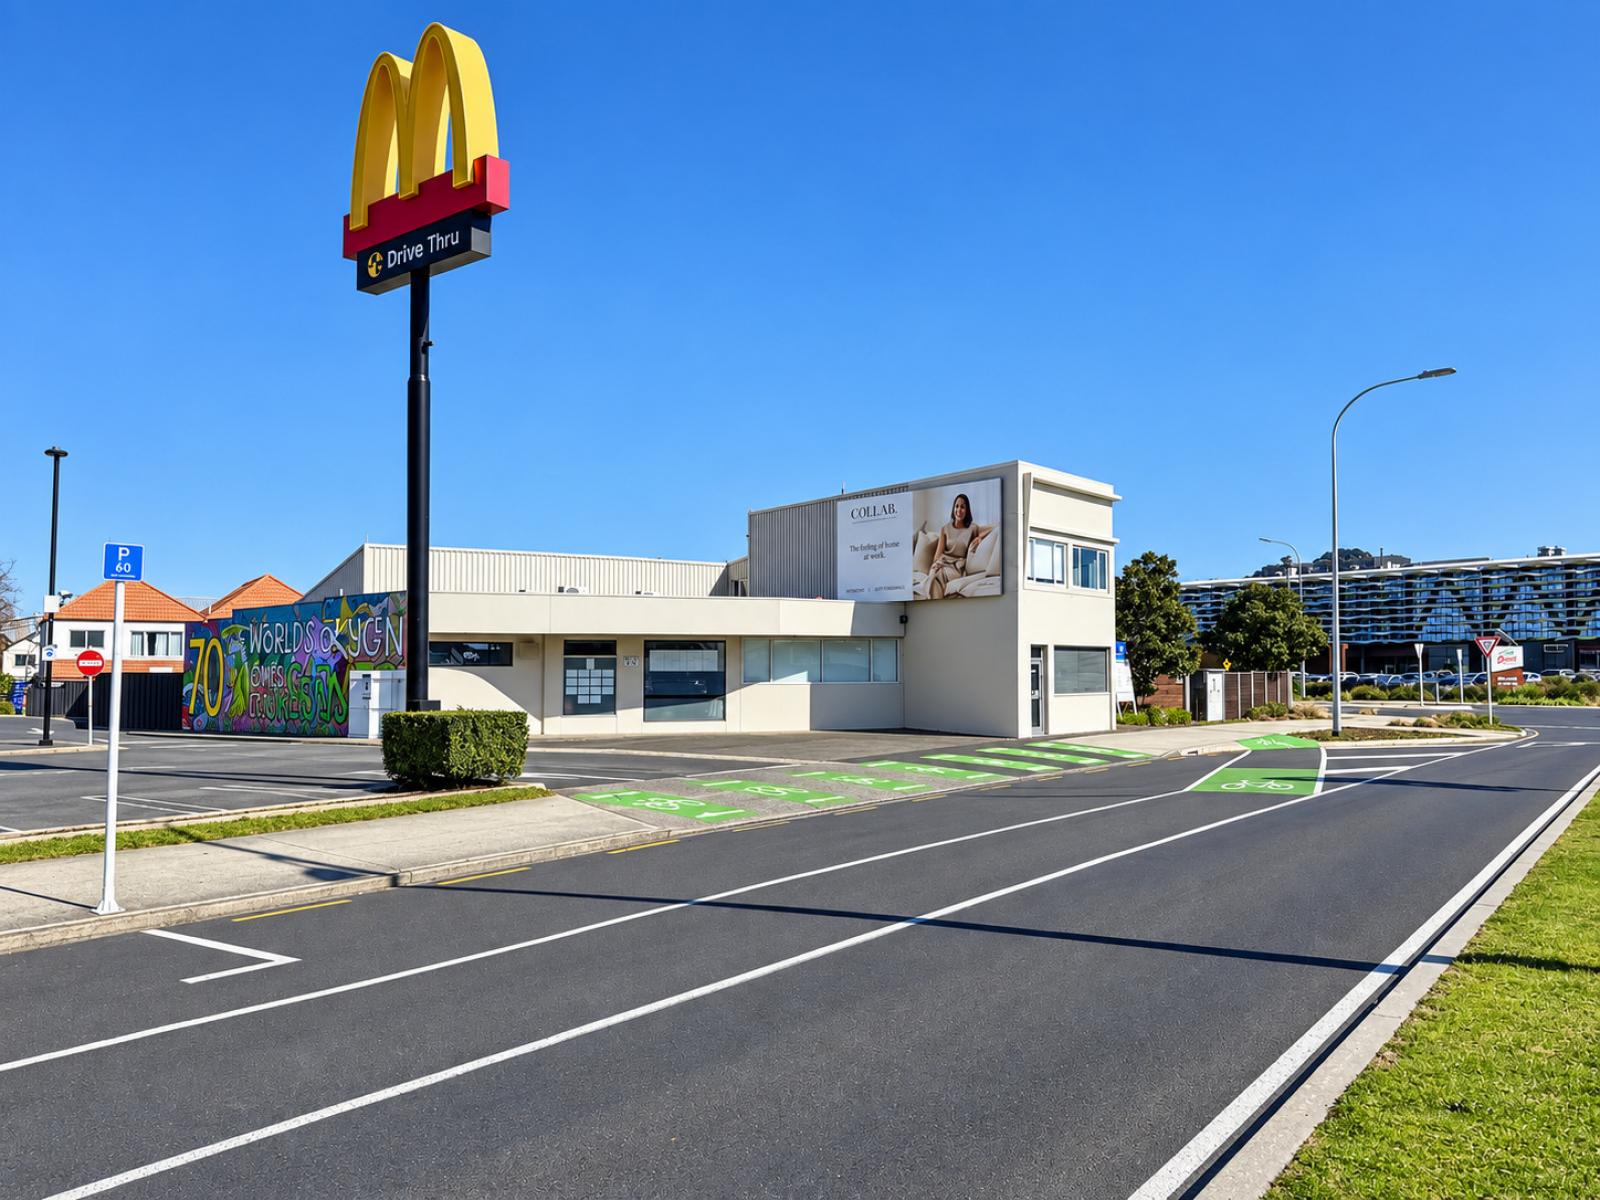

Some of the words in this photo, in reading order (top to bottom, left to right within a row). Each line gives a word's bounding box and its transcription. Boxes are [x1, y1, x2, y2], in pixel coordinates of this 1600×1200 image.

[387, 243, 423, 268] Drive
[427, 230, 459, 253] Thru
[851, 503, 897, 519] COLLAB.
[118, 546, 130, 560] P
[115, 561, 131, 573] 60
[249, 621, 315, 654] WORLDS
[189, 637, 224, 717] 70
